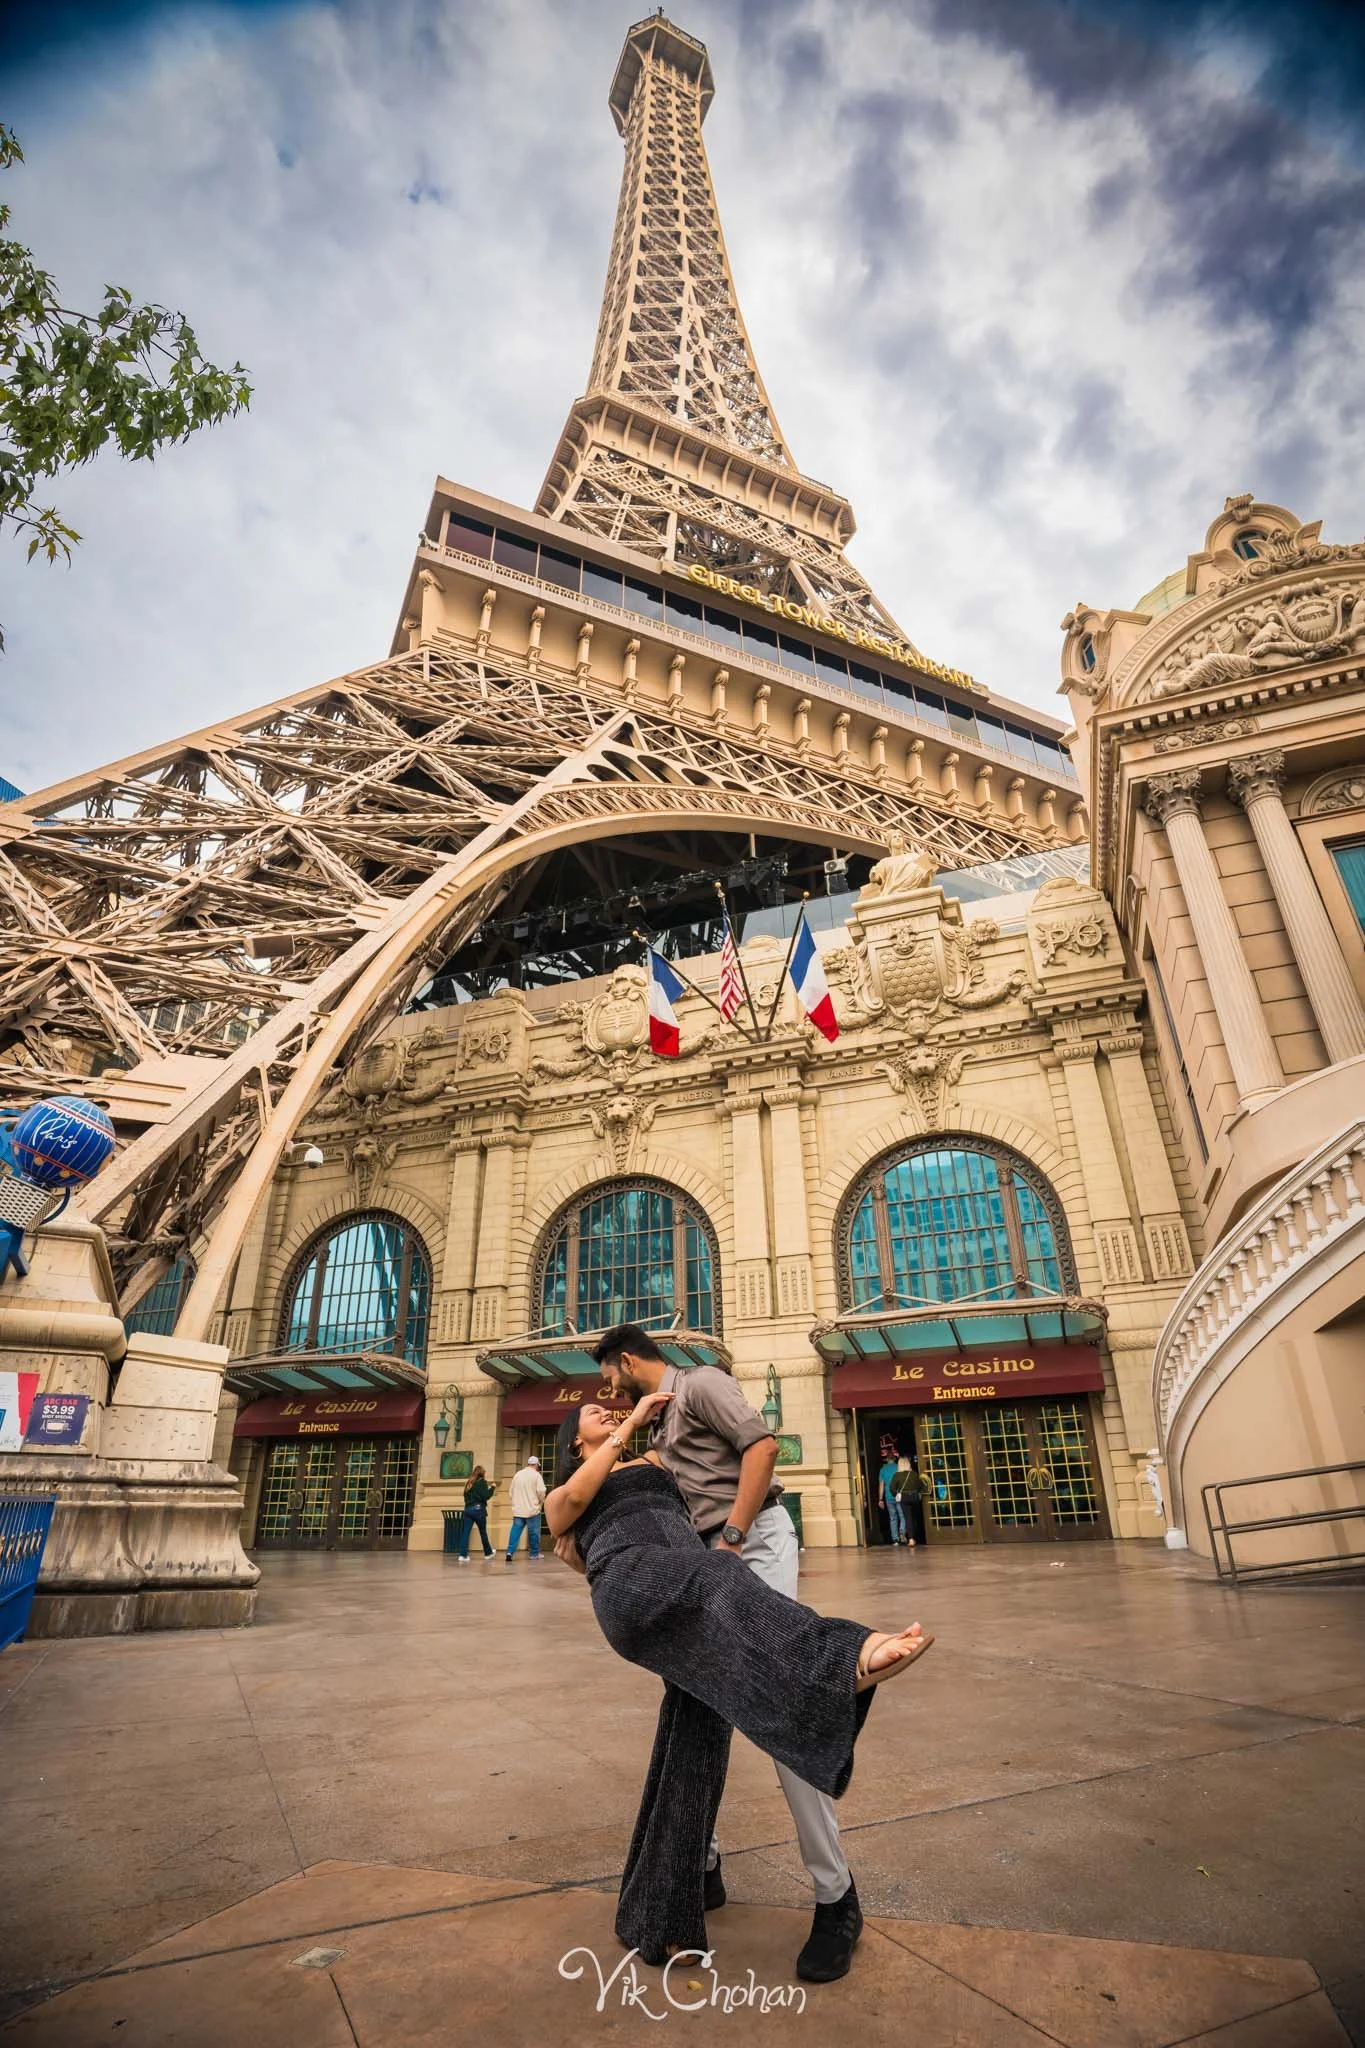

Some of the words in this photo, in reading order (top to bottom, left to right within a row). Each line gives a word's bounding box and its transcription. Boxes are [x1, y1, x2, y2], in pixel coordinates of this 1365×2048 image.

[32, 1117, 78, 1149] Paris
[891, 1364, 925, 1381] Le
[942, 1356, 1036, 1377] Casino
[553, 1387, 583, 1403] Le
[933, 1385, 996, 1401] Entrance
[43, 1404, 76, 1416] $3.99
[280, 1402, 305, 1416] Le
[314, 1399, 379, 1415] Casino
[298, 1421, 341, 1434] Entrance
